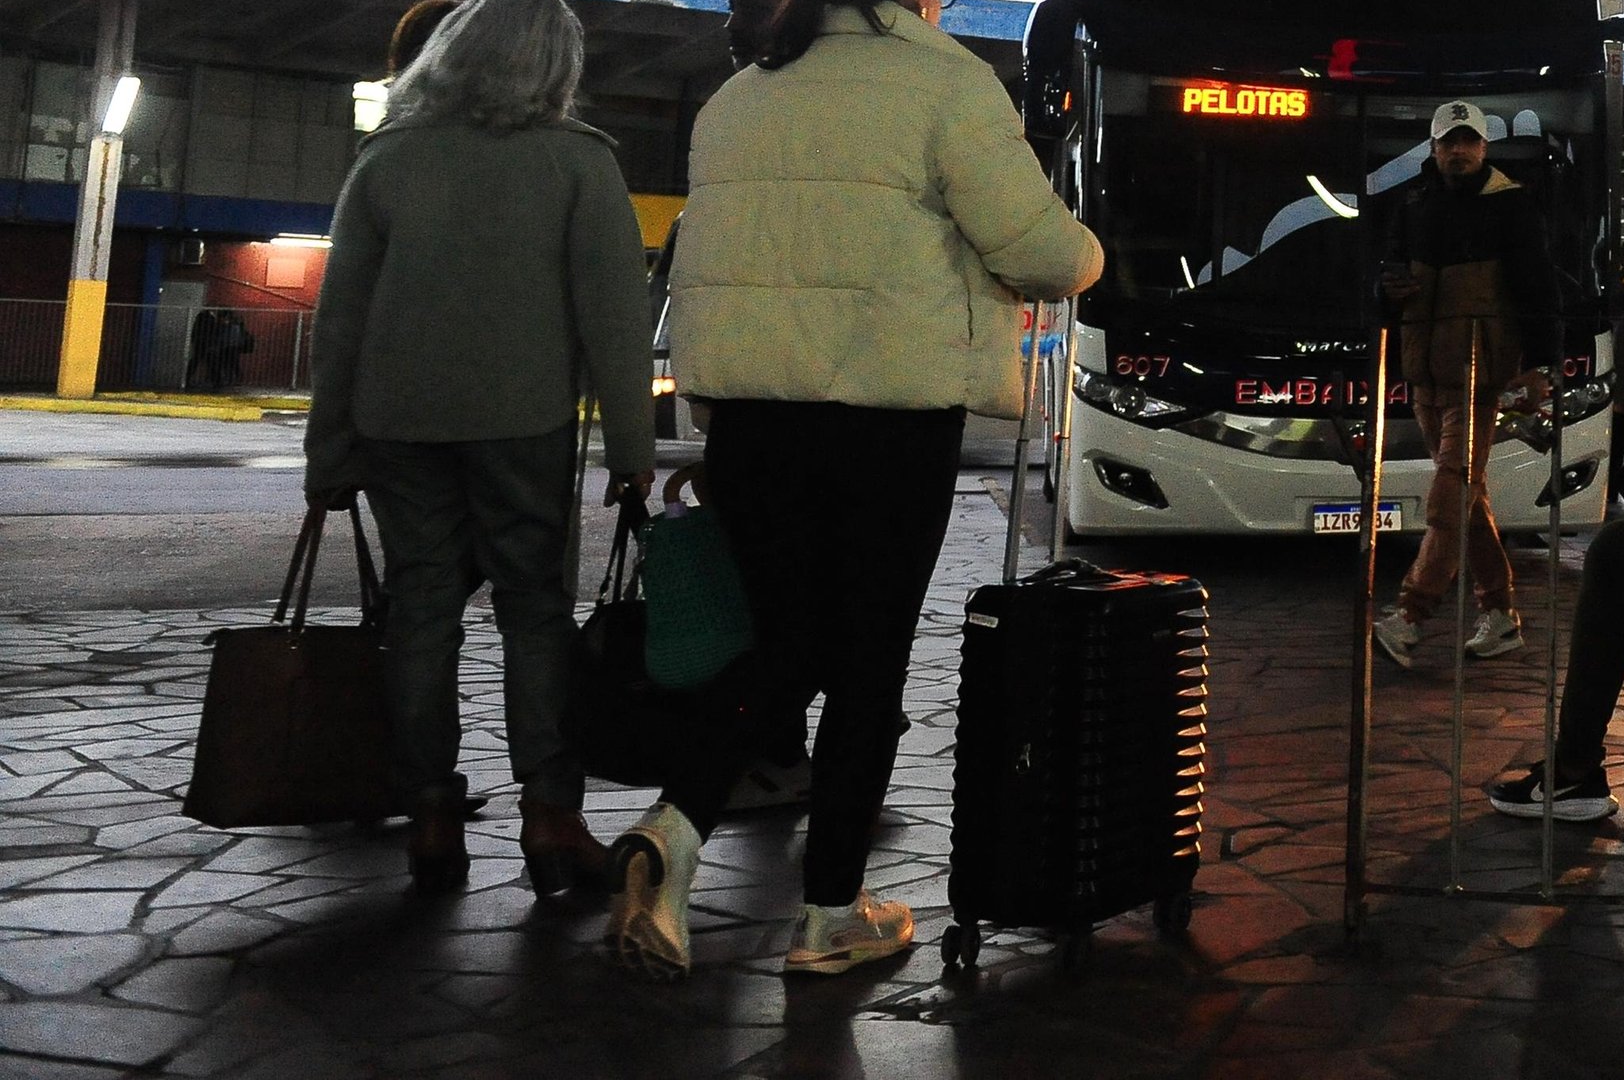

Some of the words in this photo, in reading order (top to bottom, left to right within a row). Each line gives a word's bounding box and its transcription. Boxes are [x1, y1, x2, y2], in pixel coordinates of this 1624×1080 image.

[1183, 88, 1306, 117] PELOTAS
[1115, 353, 1172, 378] 607
[1563, 355, 1591, 377] 07
